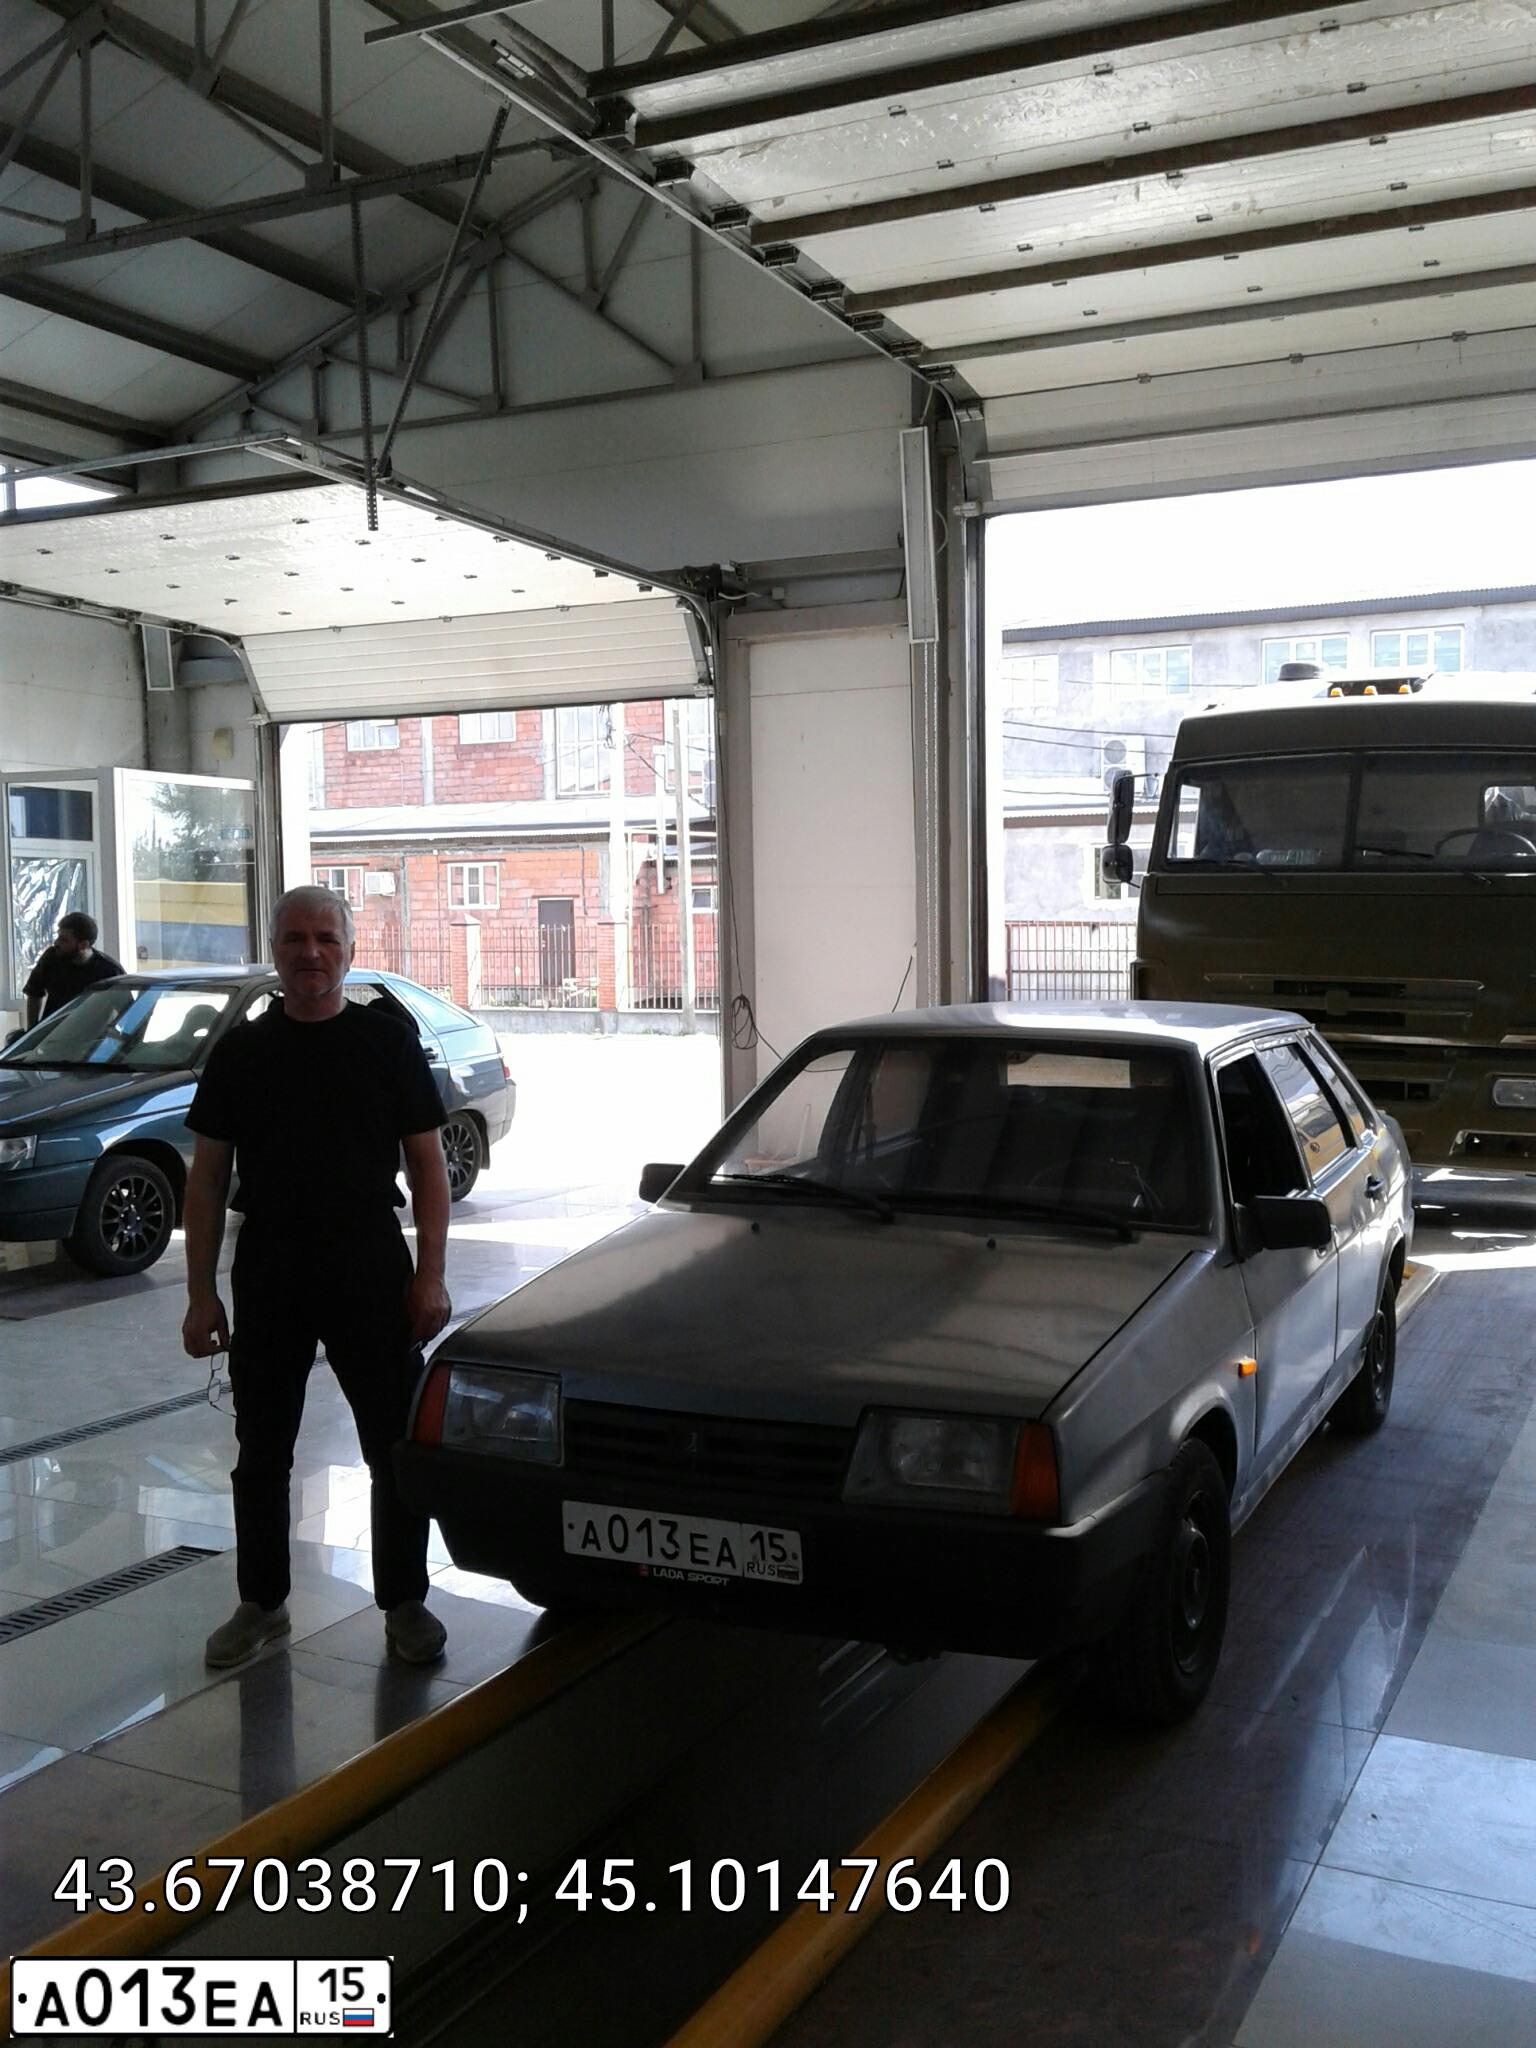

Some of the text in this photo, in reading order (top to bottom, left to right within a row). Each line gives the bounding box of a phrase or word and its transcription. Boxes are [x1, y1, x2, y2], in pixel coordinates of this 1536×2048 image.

[750, 1531, 788, 1562] 15
[653, 1567, 730, 1586] LADA SPORT
[746, 1562, 776, 1576] RUS
